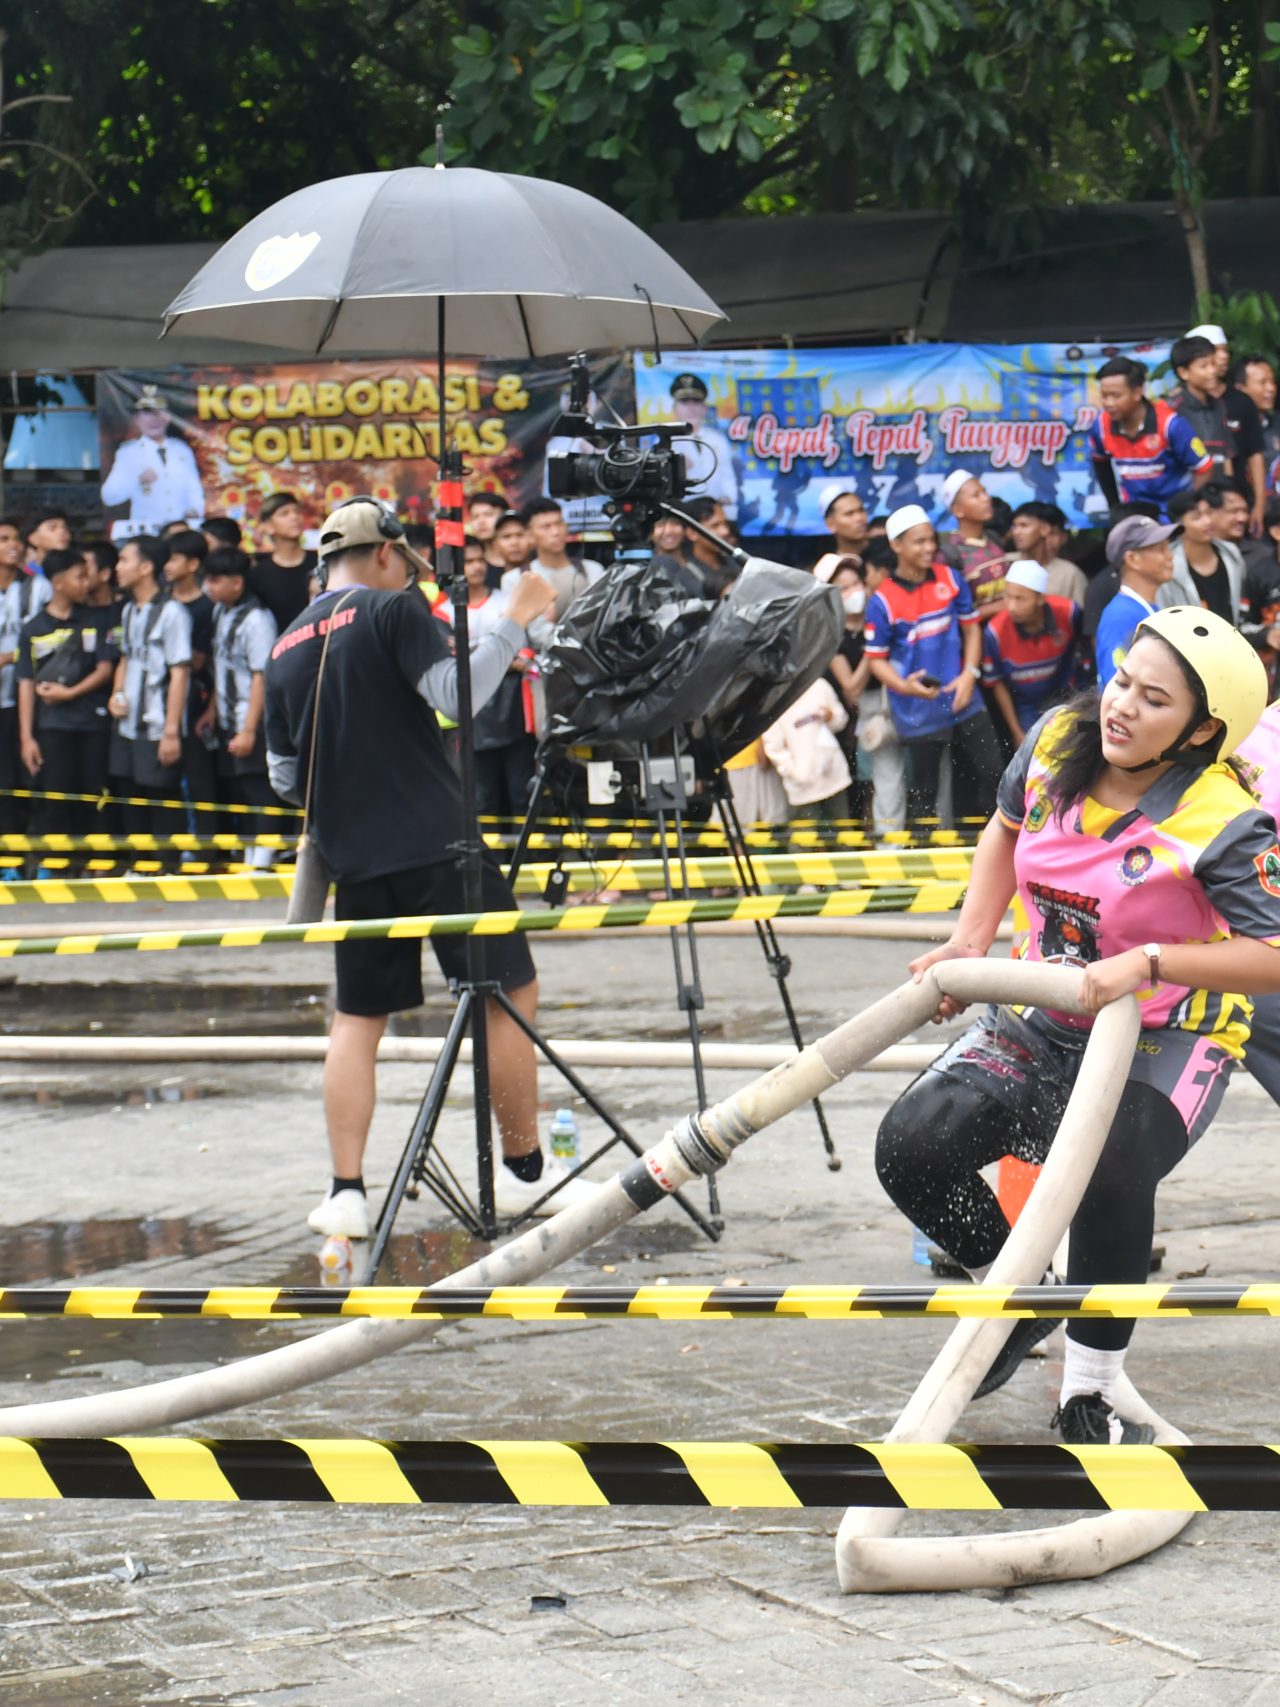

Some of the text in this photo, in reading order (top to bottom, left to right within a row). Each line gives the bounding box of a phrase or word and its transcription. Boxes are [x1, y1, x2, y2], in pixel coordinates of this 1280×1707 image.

[197, 373, 529, 420] KOLABORASI &
[846, 409, 934, 470] Tepat,
[1033, 895, 1099, 926] BANJARMASIN
